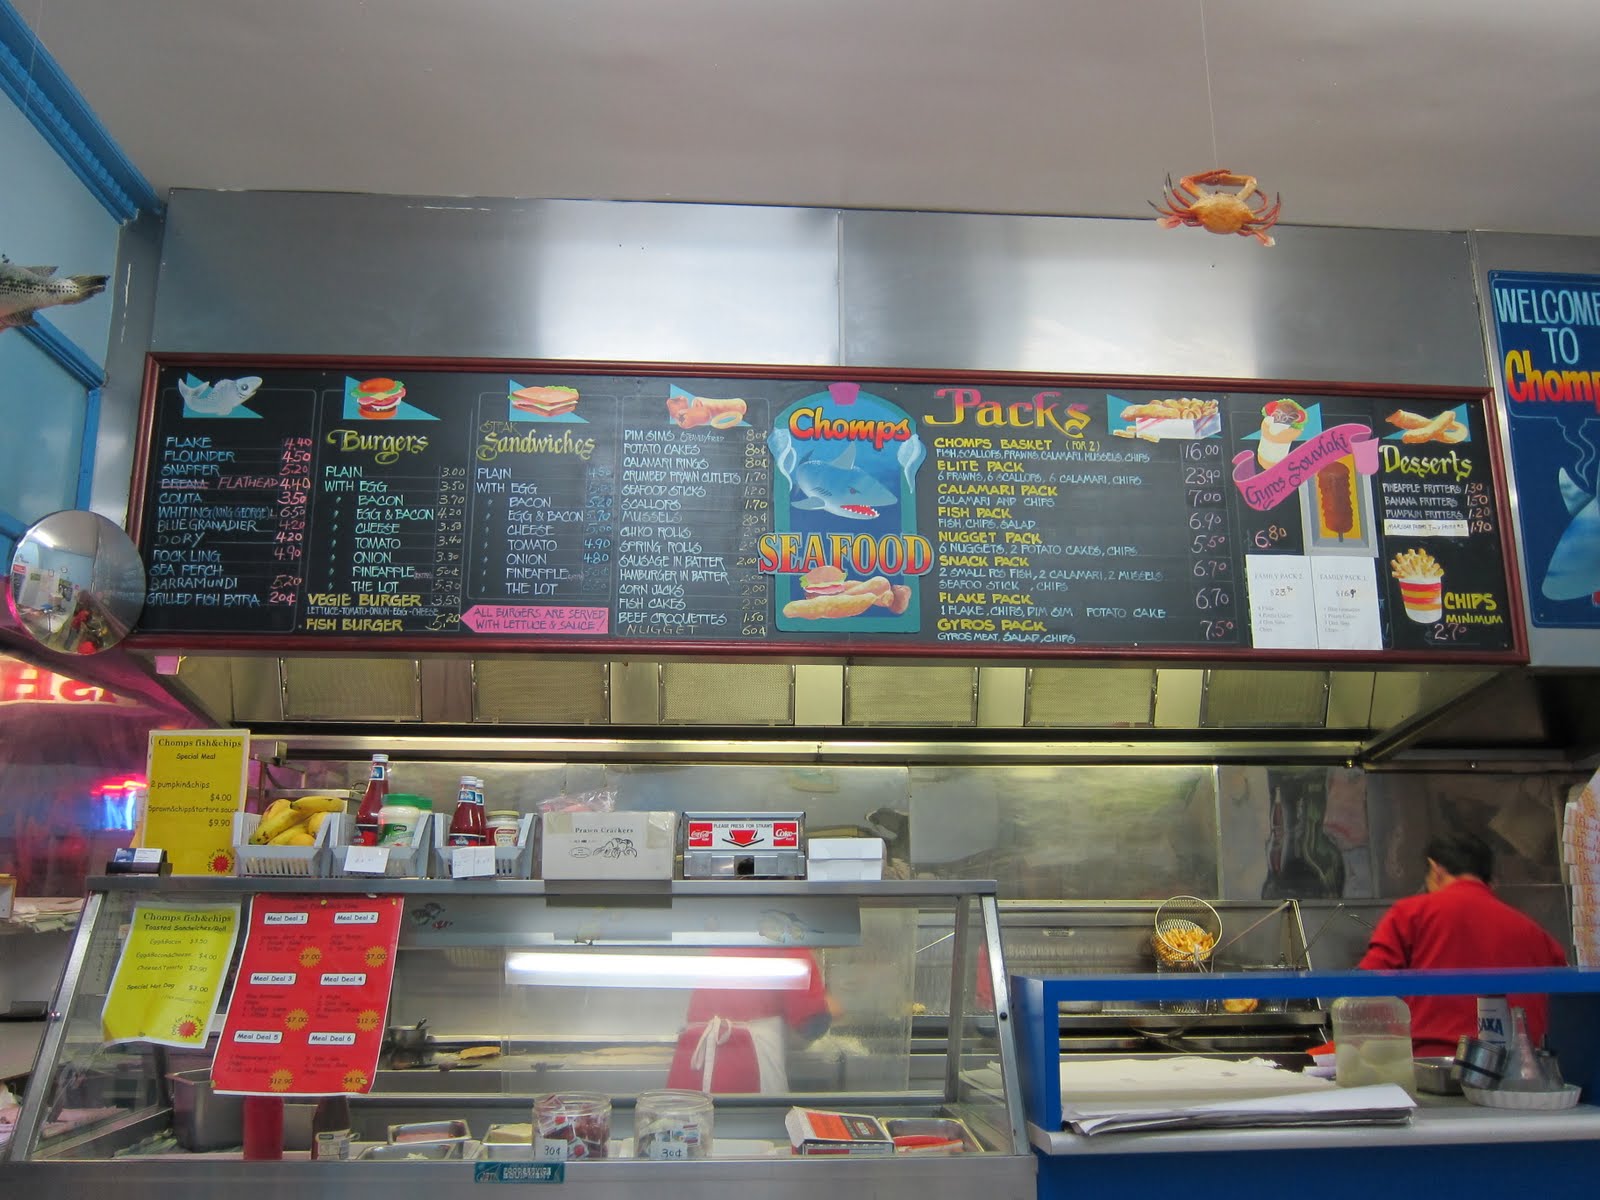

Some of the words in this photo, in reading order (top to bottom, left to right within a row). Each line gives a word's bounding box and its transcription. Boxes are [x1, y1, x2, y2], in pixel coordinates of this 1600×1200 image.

[1541, 328, 1579, 364] TO
[924, 388, 1092, 438] Packs
[788, 406, 912, 451] Chomps
[166, 437, 212, 448] FLAKE
[326, 430, 430, 464] Burgers
[476, 429, 596, 461] Sandwiches
[934, 437, 992, 449] CHOMPS
[1001, 439, 1052, 450] BASKET
[624, 443, 661, 454] POTATO
[664, 444, 700, 455] CAKES
[1185, 443, 1219, 461] 16.00
[164, 450, 236, 463] FLOUNDER
[624, 457, 672, 469] CALAMARI
[937, 460, 979, 471] ELITE
[987, 461, 1024, 472] PACK
[1378, 445, 1472, 482] Desserts
[325, 466, 363, 477] PLAIN
[441, 468, 465, 476] 3.00
[478, 468, 512, 479] PLAIN
[1246, 477, 1286, 510] Gyros
[1288, 432, 1349, 487] Souvlaki
[324, 481, 354, 491] WITH
[360, 481, 388, 492] EGG
[476, 482, 504, 494] WITH
[511, 483, 537, 495] EGG
[622, 485, 667, 496] SEAFOOD
[668, 486, 706, 497] STICKS
[938, 484, 1015, 496] CALAMARI
[1021, 485, 1057, 496] PACK
[1382, 483, 1420, 494] PINEAPPLE
[1424, 483, 1461, 494] FRITTERS
[358, 494, 404, 506] BACON
[509, 497, 551, 508] BACON
[621, 499, 681, 510] SCALLOPS
[938, 496, 990, 505] CALAMARI
[1384, 496, 1418, 506] BANANA
[1420, 496, 1458, 507] FRITTERS
[357, 509, 381, 520] EGG
[395, 509, 434, 520] BACON
[548, 510, 583, 522] BACON
[938, 507, 970, 518] FISH
[976, 508, 1012, 518] PACK
[1386, 509, 1422, 518] PUMPKIN
[1425, 510, 1463, 520] FRITTERS
[620, 526, 652, 537] CHIKO
[1255, 525, 1287, 548] 6.80
[355, 537, 401, 549] TOMATO
[938, 532, 997, 543] NUGGET
[1006, 532, 1043, 544] PACK
[508, 540, 557, 550] TOMATO
[619, 540, 661, 552] SPRING
[1021, 545, 1061, 554] POTATO
[353, 552, 392, 563] ONION
[506, 554, 547, 565] ONION
[618, 555, 669, 567] SAUSAGE
[674, 556, 682, 566] IN
[759, 534, 934, 576] SEAFOOD
[939, 556, 989, 567] SNACK
[995, 556, 1029, 566] PACK
[353, 566, 414, 578] PINEAPPLE
[506, 568, 568, 580] PINEAPPLE
[950, 568, 986, 578] SMALL
[352, 581, 373, 592] THE
[378, 581, 399, 593] LOT
[506, 583, 529, 594] THE
[534, 584, 558, 595] LOT
[619, 584, 647, 595] CORN
[308, 593, 352, 606] VEGIE
[359, 593, 422, 606] BURGER
[619, 598, 643, 609] FISH
[648, 599, 686, 610] CAKES
[939, 592, 986, 604] FLAKE
[992, 594, 1034, 605] PACK
[1443, 592, 1497, 610] CHIPS
[474, 608, 492, 617] ALL
[618, 612, 647, 624] BEEF
[1087, 608, 1127, 618] POTATO
[1133, 609, 1166, 618] CAKE
[1446, 613, 1503, 624] MINIMUM
[306, 619, 336, 630] FISH
[342, 619, 403, 631] BURGER
[476, 620, 499, 629] WITH
[503, 620, 546, 629] LETTUCE
[626, 624, 698, 636] NUGGET
[937, 618, 996, 631] GYROS
[1001, 620, 1047, 632] PACK
[159, 739, 193, 747] Chomps
[196, 739, 241, 748] fish&chips
[210, 794, 231, 802] $4.00
[208, 819, 230, 827] $9.90
[144, 912, 180, 922] Chomps
[183, 913, 231, 923] fish&chips
